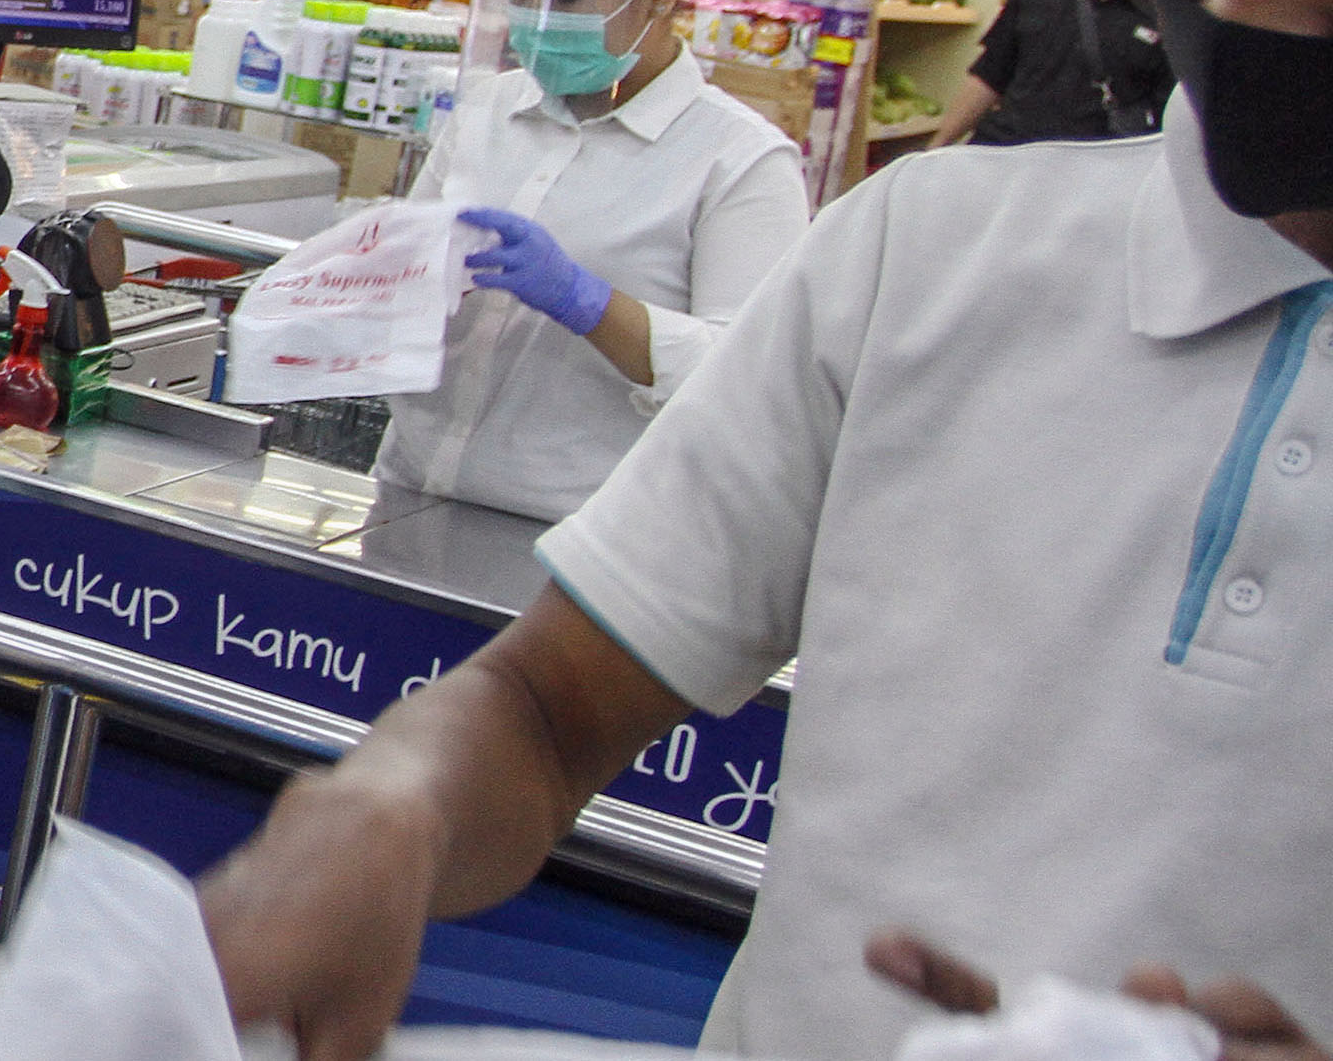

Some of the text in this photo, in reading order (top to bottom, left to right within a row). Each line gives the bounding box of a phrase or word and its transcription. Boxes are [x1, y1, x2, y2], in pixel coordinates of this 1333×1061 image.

[316, 263, 429, 293] Supermaket
[14, 553, 180, 640] cukup
[215, 593, 366, 692] kamu
